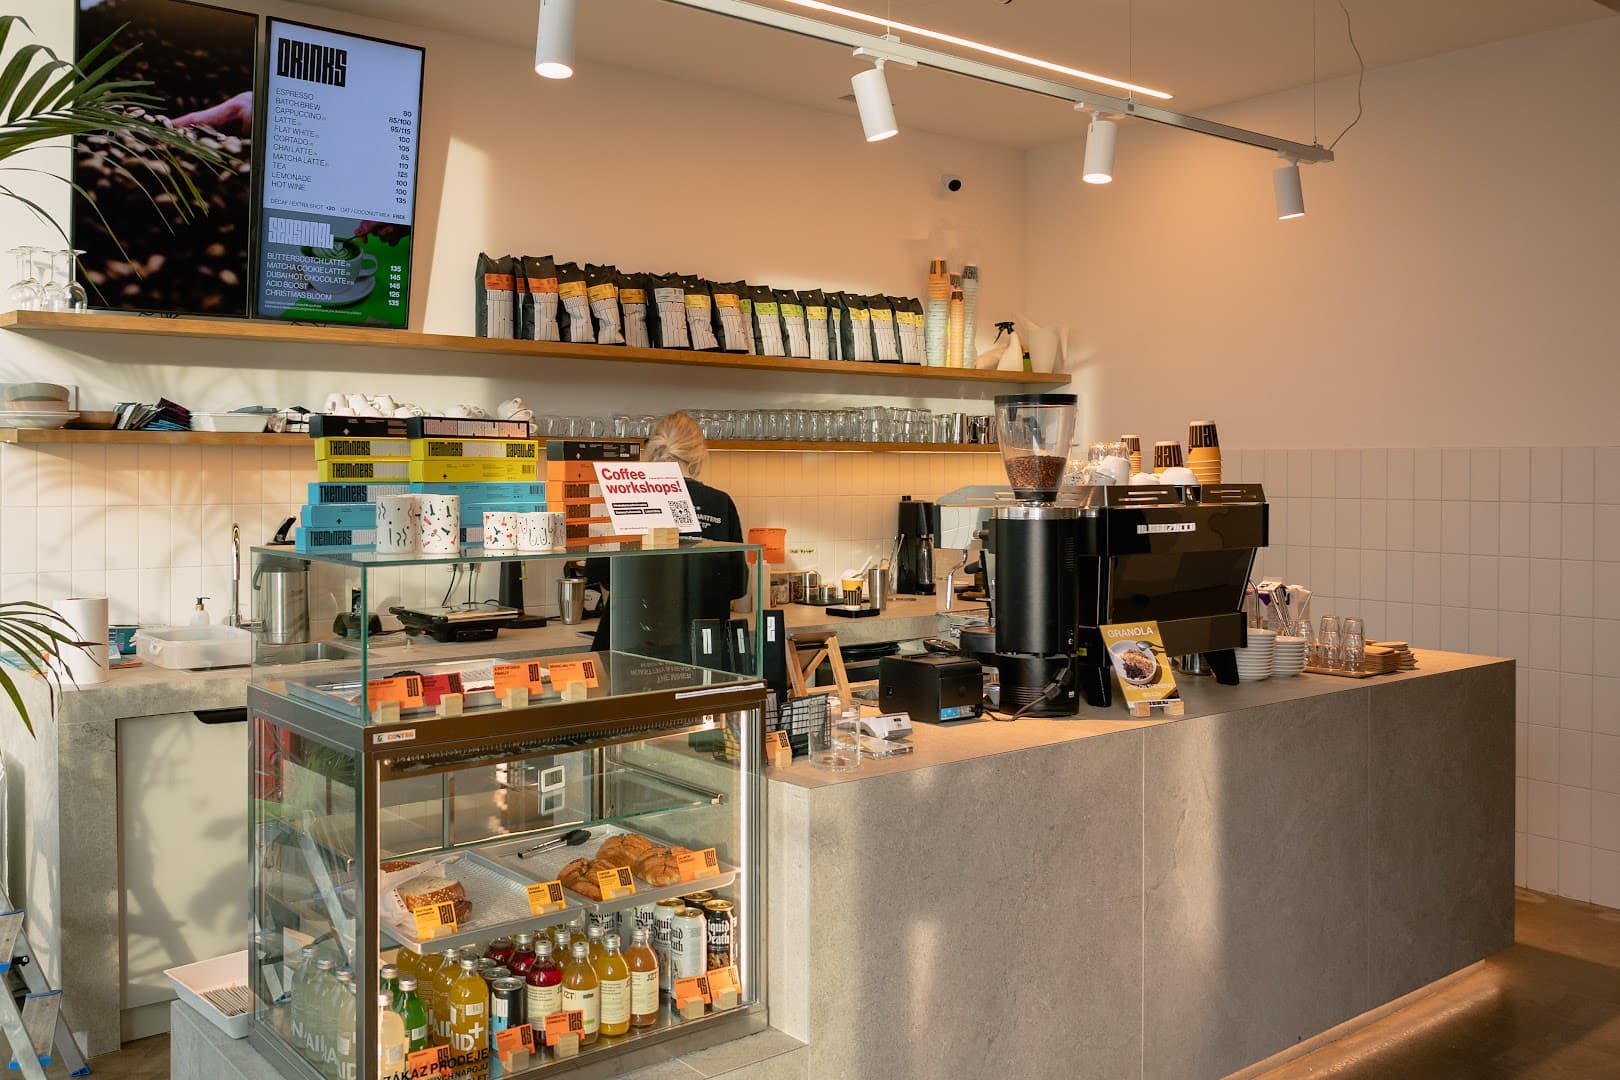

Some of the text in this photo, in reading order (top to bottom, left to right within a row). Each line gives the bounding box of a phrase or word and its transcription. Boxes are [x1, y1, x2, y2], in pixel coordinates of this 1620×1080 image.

[277, 38, 347, 87] DRINKS
[275, 87, 314, 100] ESPRESSO
[275, 97, 320, 111] BATCH BREW
[275, 106, 321, 120] CAPPUCCINO
[274, 115, 297, 126] LATTE
[274, 124, 315, 138] FLAT WHITE
[273, 134, 309, 146] CORTADO
[273, 143, 313, 156] CHAI LATTE
[272, 153, 325, 167] MATCHA LATTE
[272, 161, 286, 170] TEA
[399, 162, 409, 170] 110
[271, 170, 311, 183] LEMONADE
[396, 179, 408, 187] 100
[271, 180, 305, 191] HOT WINE
[267, 252, 346, 268] BUTTERSCOTCH LATTE
[266, 261, 346, 276] MATCHA COOKIE LATTE
[265, 279, 282, 288] ACID
[266, 270, 347, 285] DUBAI HOT CHOCOLATE
[265, 288, 332, 301] CHRISTMAS BLOOM
[601, 468, 646, 480] Coffee
[606, 480, 682, 495] workshops!
[1107, 626, 1154, 638] GRANOLA
[528, 664, 540, 682] 90
[582, 661, 595, 679] 90
[406, 678, 420, 697] 90
[438, 903, 455, 925] 120
[430, 1048, 489, 1075] PRODEJE
